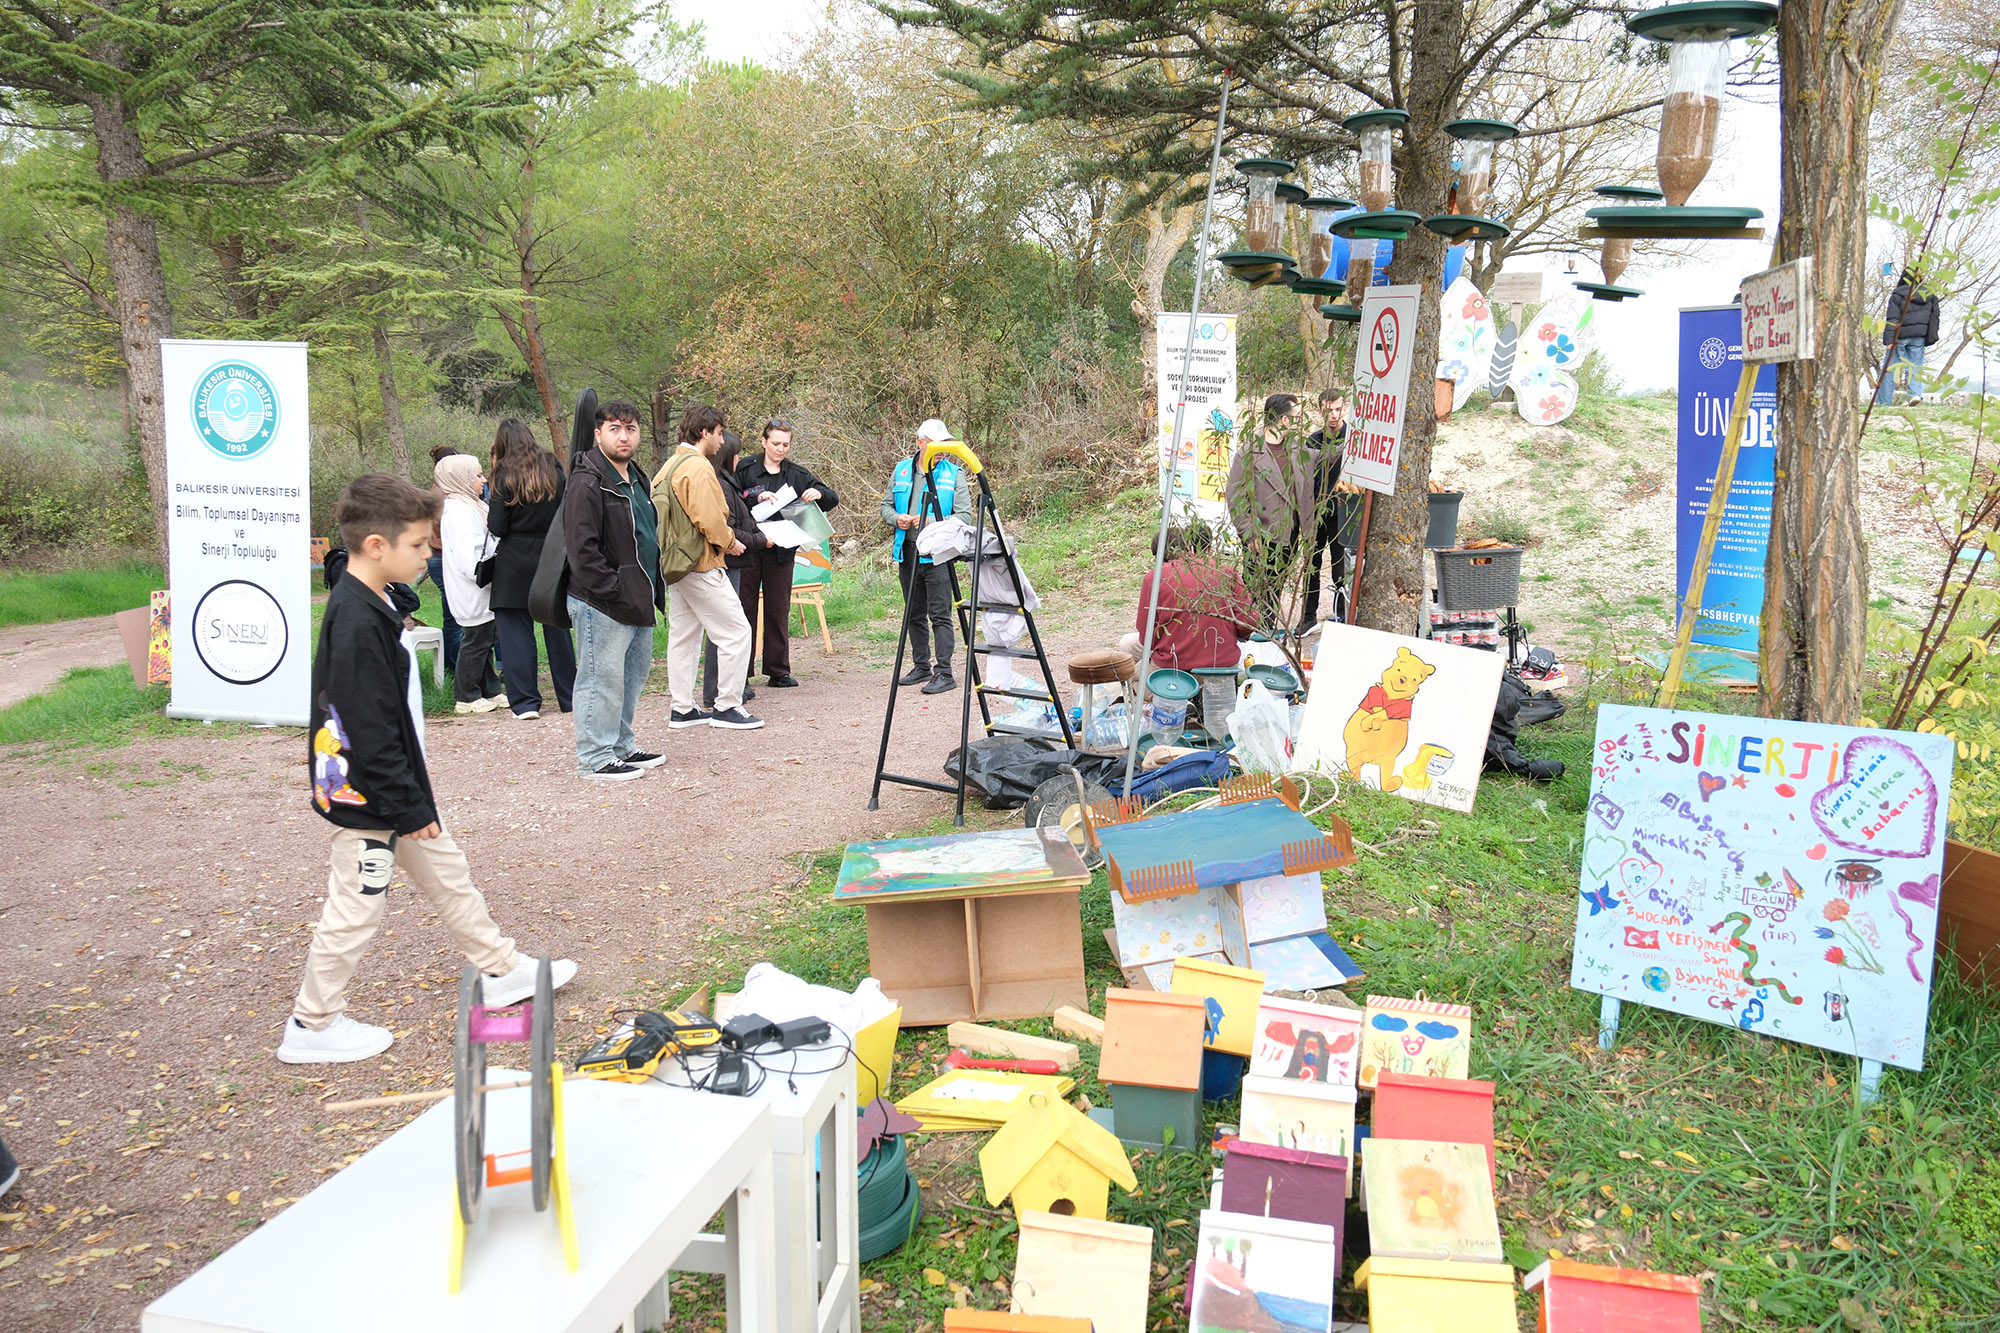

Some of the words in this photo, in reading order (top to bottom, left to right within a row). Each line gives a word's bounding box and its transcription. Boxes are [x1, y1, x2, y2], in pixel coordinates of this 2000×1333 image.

[198, 370, 227, 418] BALIKESİR
[226, 443, 248, 453] 1992
[175, 483, 229, 494] BALIKESİR
[231, 484, 300, 497] ÜNİVERSİTESİ
[176, 504, 201, 520] Bilim,
[203, 506, 249, 522] Toplumsal
[251, 508, 300, 525] Dayanışma
[234, 529, 245, 538] ve
[201, 542, 230, 559] Sinerji
[232, 544, 277, 561] Topluluğu
